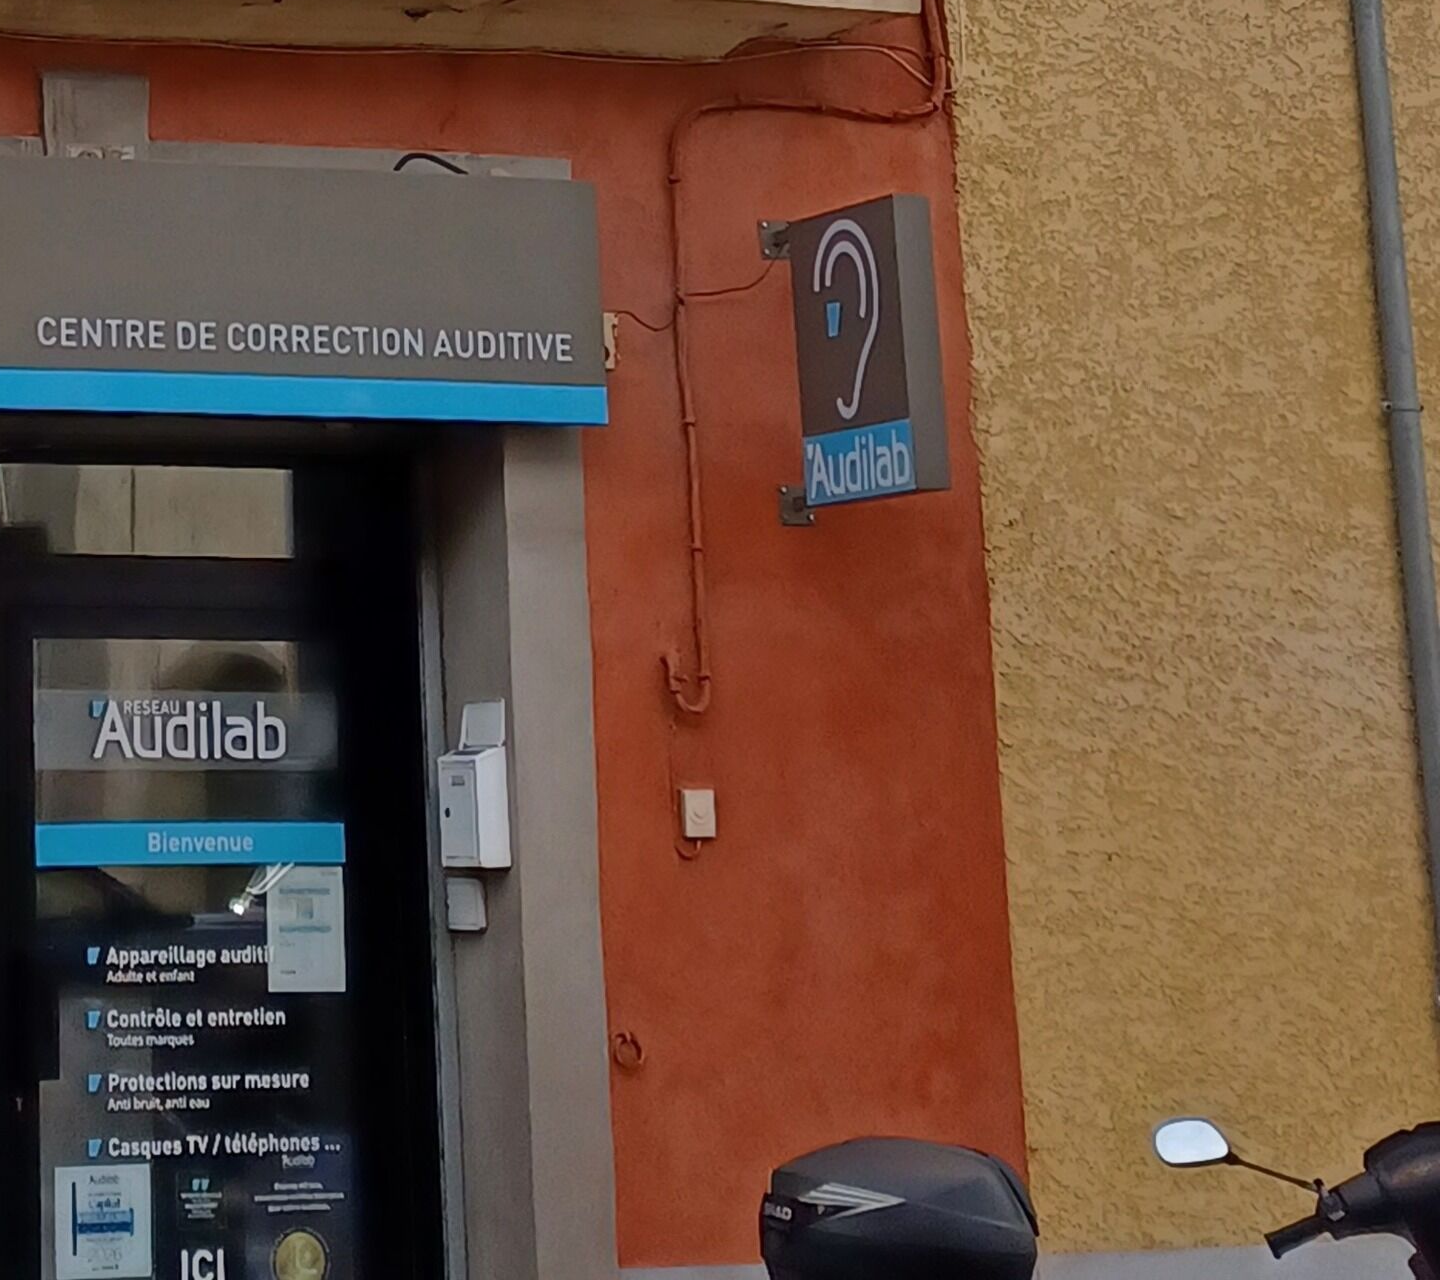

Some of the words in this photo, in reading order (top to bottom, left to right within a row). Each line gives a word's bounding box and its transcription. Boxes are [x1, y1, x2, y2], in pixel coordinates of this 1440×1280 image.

[37, 316, 166, 350] CENTRE
[175, 320, 217, 351] DE
[226, 321, 424, 358] CORRECTION
[433, 329, 574, 363] AUDITIVE
[808, 428, 911, 500] Audilab
[92, 699, 287, 760] Audilab
[147, 831, 254, 853] Bienvenue
[106, 945, 216, 968] Appareillage
[106, 971, 143, 983] Adulte
[145, 970, 157, 982] et
[159, 970, 195, 982] enfant
[106, 1007, 182, 1028] Contrôle
[186, 1008, 203, 1027] et
[207, 1007, 286, 1027] entretien
[107, 1034, 144, 1047] Toutes
[146, 1033, 195, 1048] marques
[108, 1072, 208, 1092] Protections
[211, 1074, 241, 1091] sur
[244, 1072, 310, 1089] mesure
[107, 1097, 132, 1111] Anti
[165, 1096, 187, 1109] anti
[189, 1098, 210, 1109] eau
[108, 1137, 182, 1159] Casques
[185, 1135, 208, 1155] TV
[225, 1132, 321, 1157] téléphones
[180, 1248, 225, 1280] ICI
